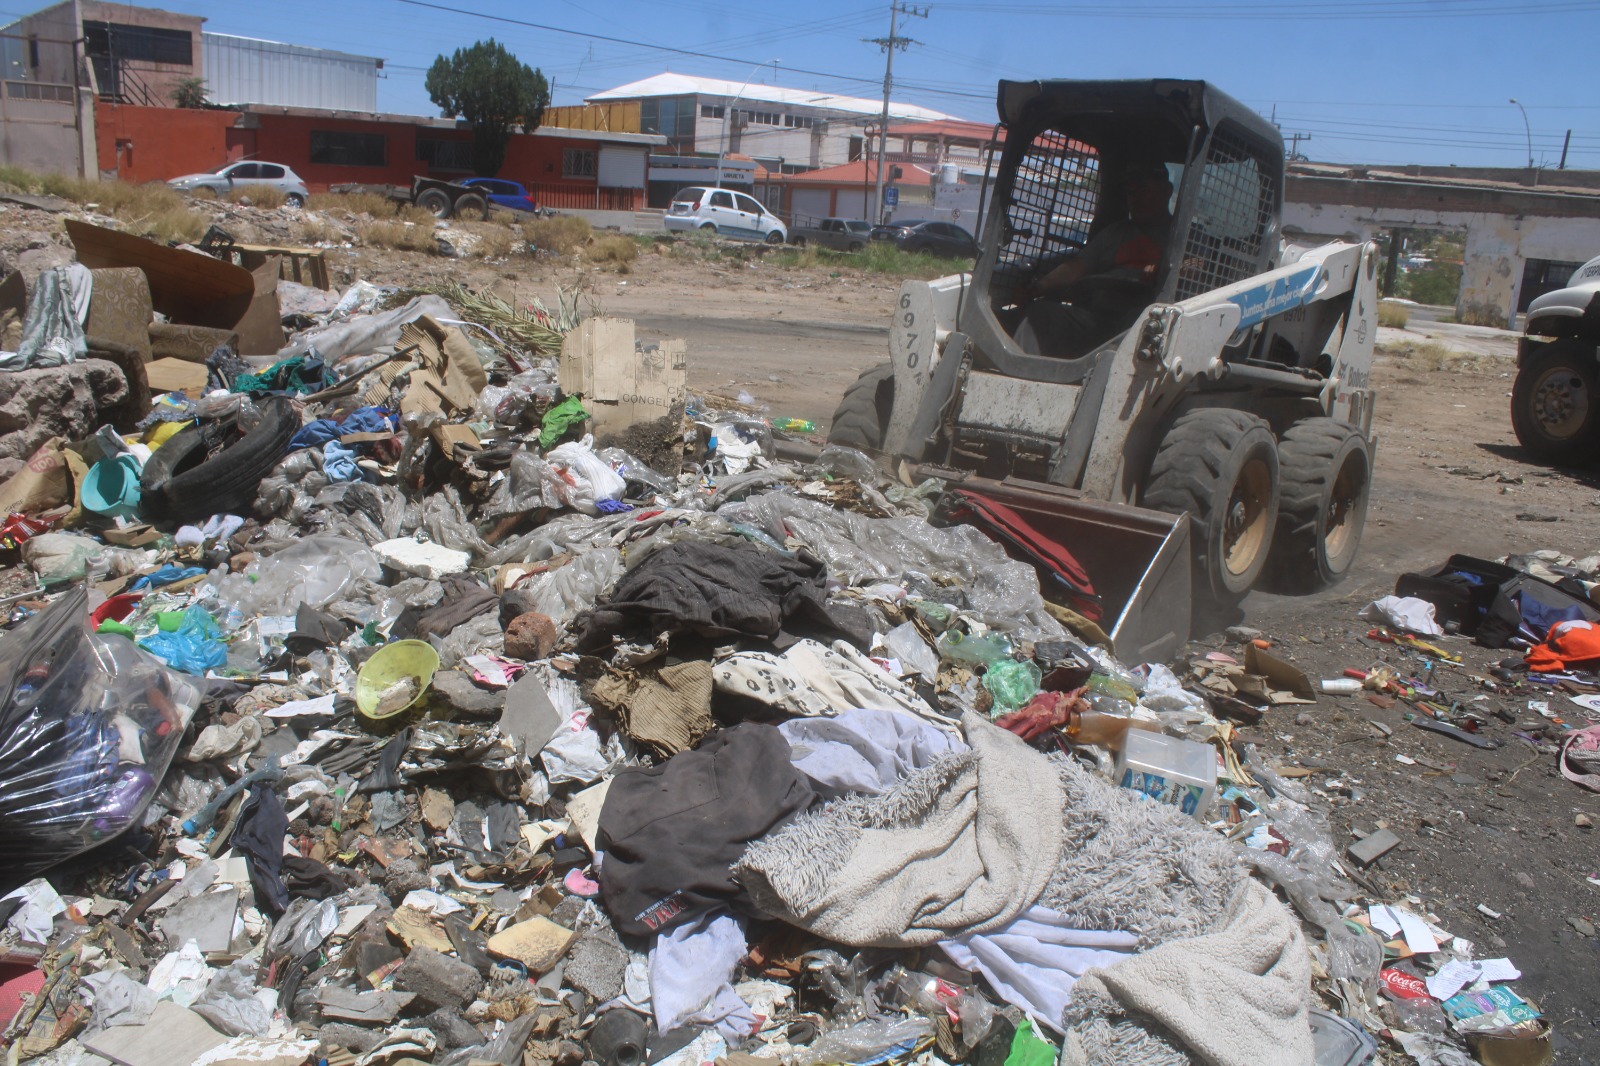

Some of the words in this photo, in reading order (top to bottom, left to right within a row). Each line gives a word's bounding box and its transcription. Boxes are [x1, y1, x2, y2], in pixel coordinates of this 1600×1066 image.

[1347, 366, 1370, 388] Bobcat
[32, 455, 54, 471] 100
[642, 894, 688, 930] MMA
